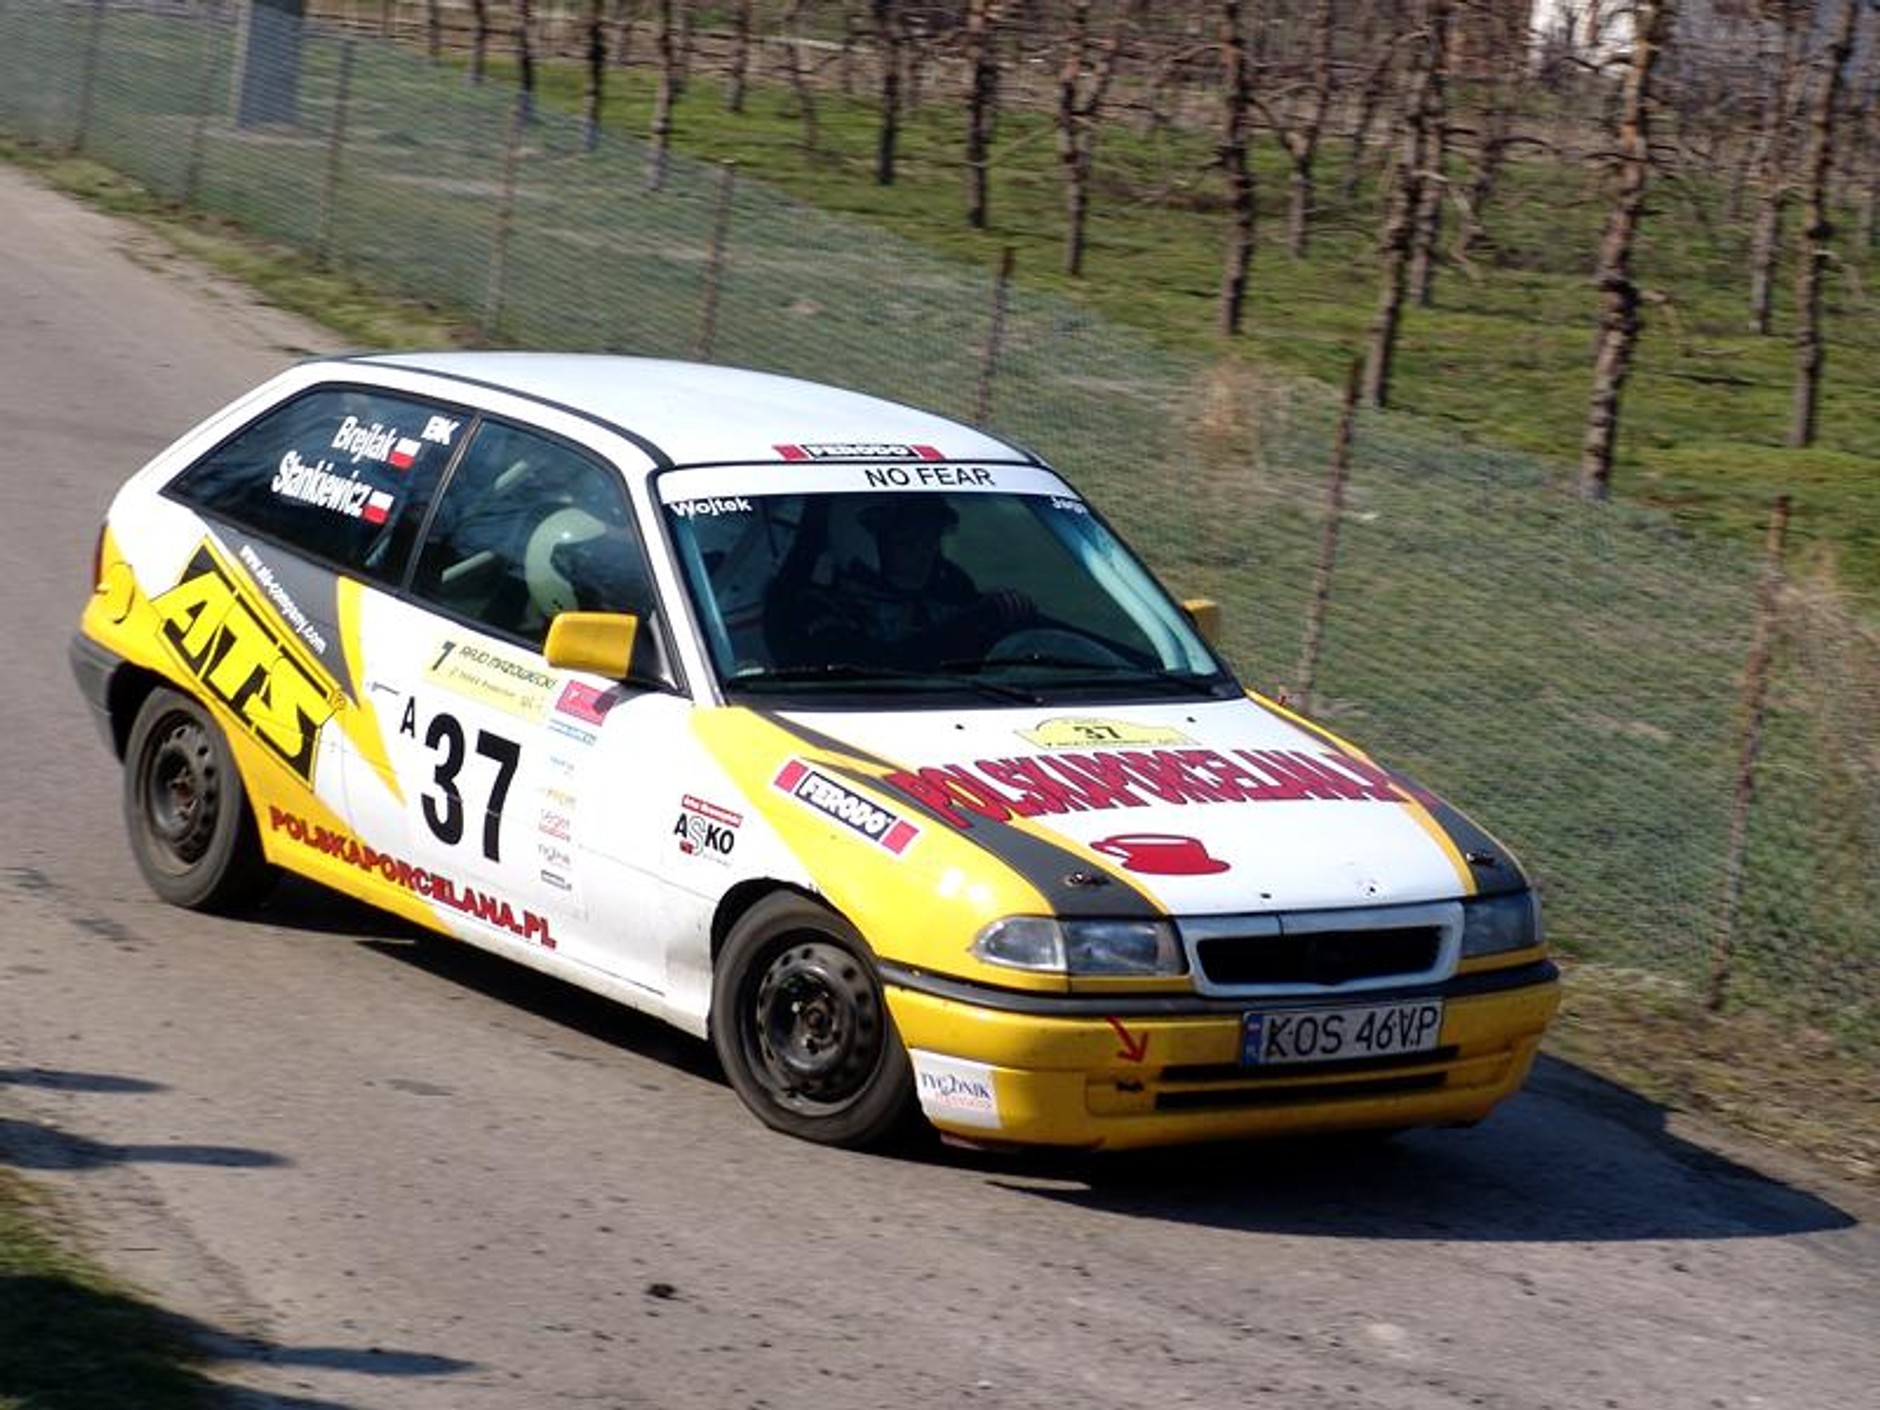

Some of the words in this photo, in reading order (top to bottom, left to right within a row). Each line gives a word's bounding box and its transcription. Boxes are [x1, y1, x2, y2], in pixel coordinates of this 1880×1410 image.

[270, 450, 373, 519] Stankiewicz
[864, 467, 911, 487] NO
[916, 467, 996, 486] FEAR
[670, 498, 752, 517] Wojtek
[149, 568, 332, 759] ATS
[400, 696, 416, 739] A
[1074, 726, 1122, 739] 37
[419, 712, 522, 862] 37
[798, 770, 891, 836] FERODO
[674, 812, 735, 857] ASKO
[269, 805, 558, 949] POLSKAPORCELANA.PL
[1265, 1014, 1346, 1058] KOS
[1354, 1005, 1439, 1051] 46VP
